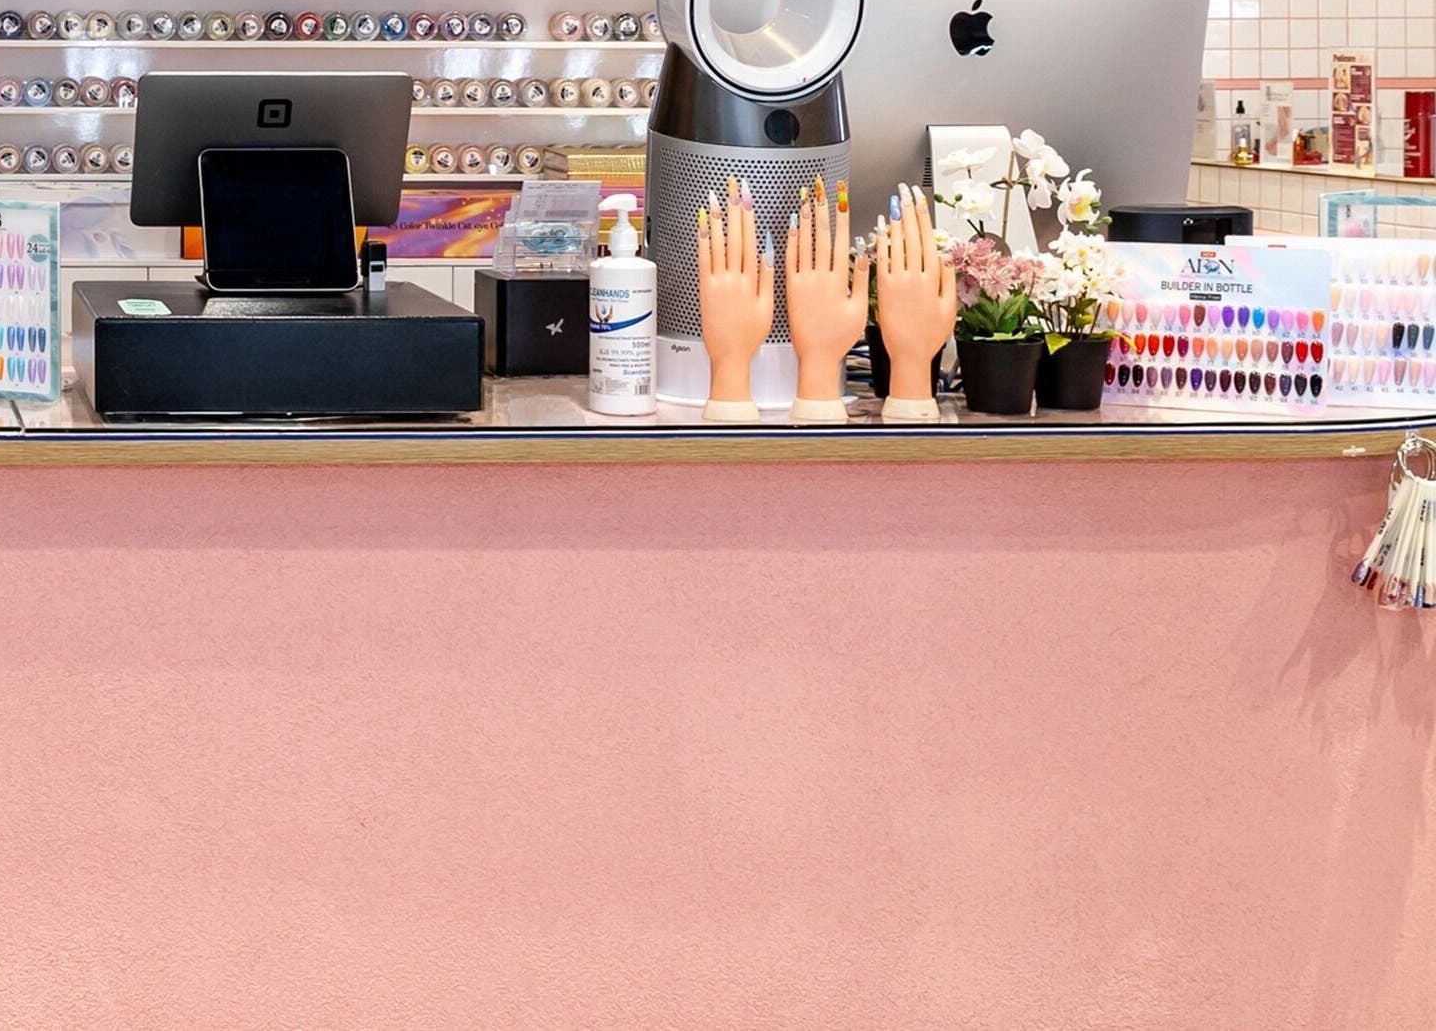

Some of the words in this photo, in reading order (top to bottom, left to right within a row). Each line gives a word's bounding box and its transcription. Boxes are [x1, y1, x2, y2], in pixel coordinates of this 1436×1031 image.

[1161, 280, 1202, 291] BUILDER
[1203, 282, 1214, 292] IN
[1215, 283, 1253, 295] BOTTLE
[670, 344, 691, 354] dyson
